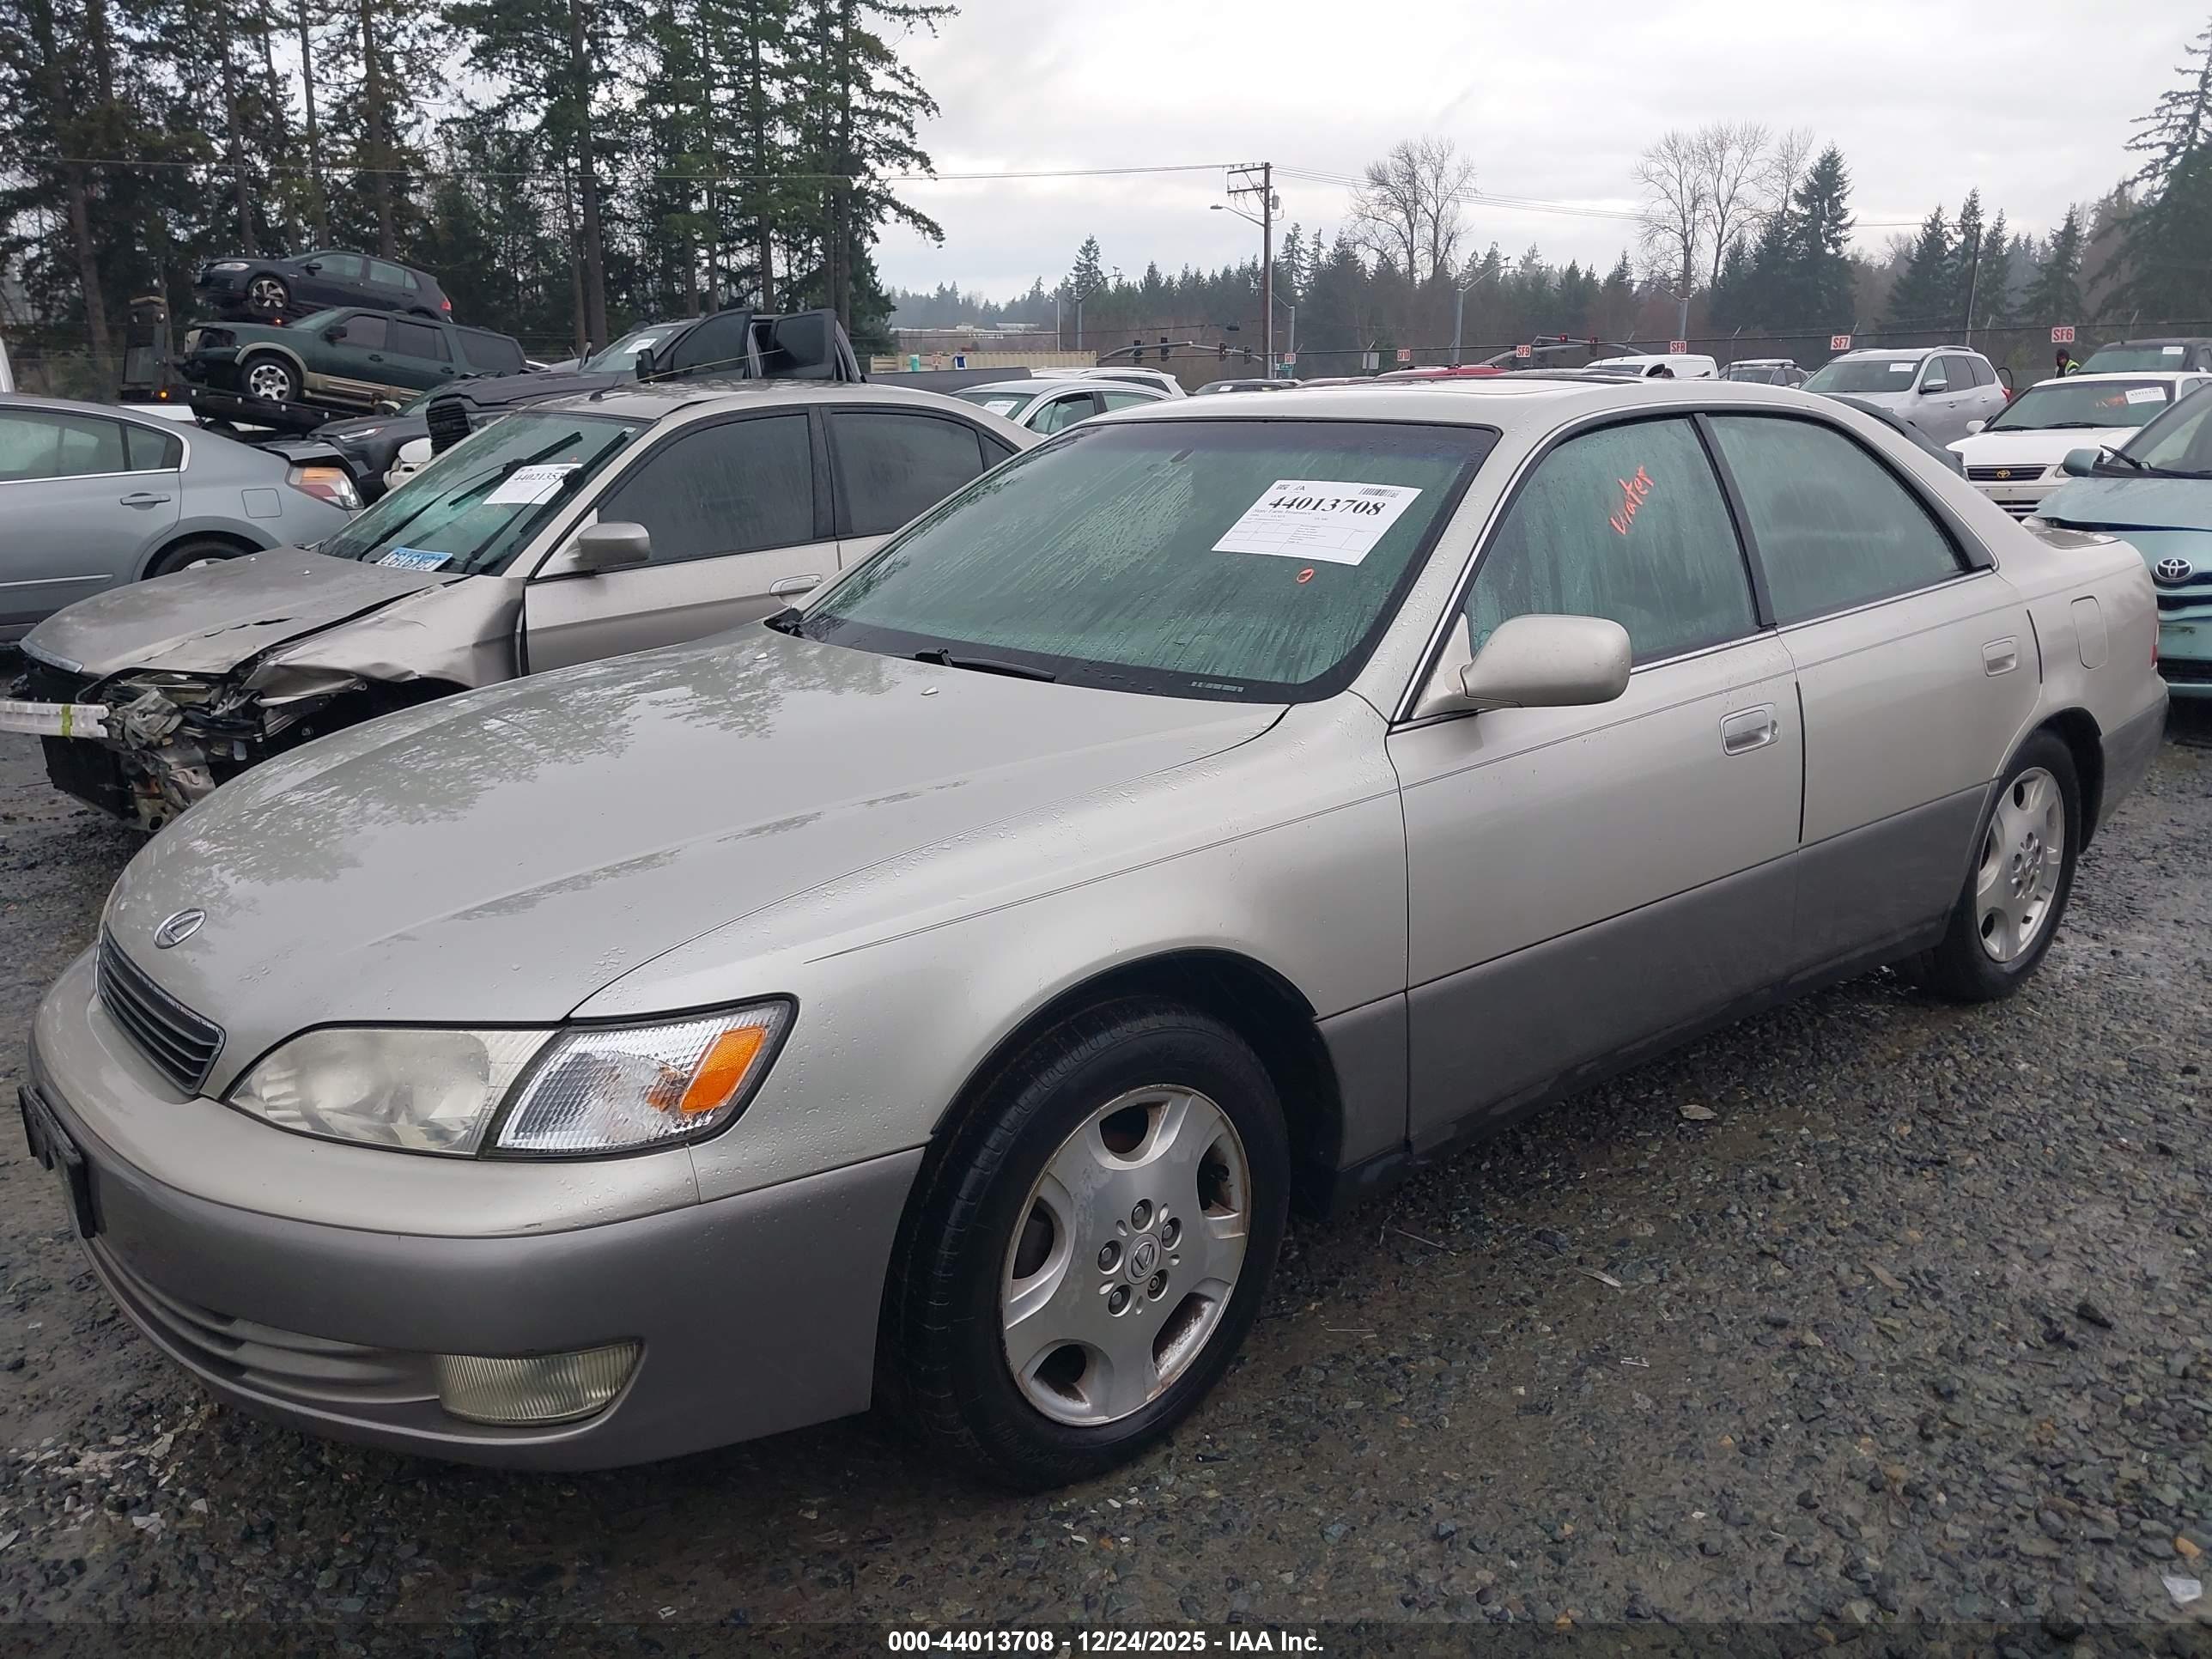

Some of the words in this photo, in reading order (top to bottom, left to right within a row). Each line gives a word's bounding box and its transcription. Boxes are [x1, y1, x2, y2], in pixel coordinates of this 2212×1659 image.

[2053, 328, 2073, 341] SF6
[1671, 342, 1686, 353] SF8
[1832, 337, 1849, 349] SF7
[1517, 346, 1530, 357] SF9
[1268, 495, 1386, 515] 44013708
[1610, 465, 1654, 536] Water
